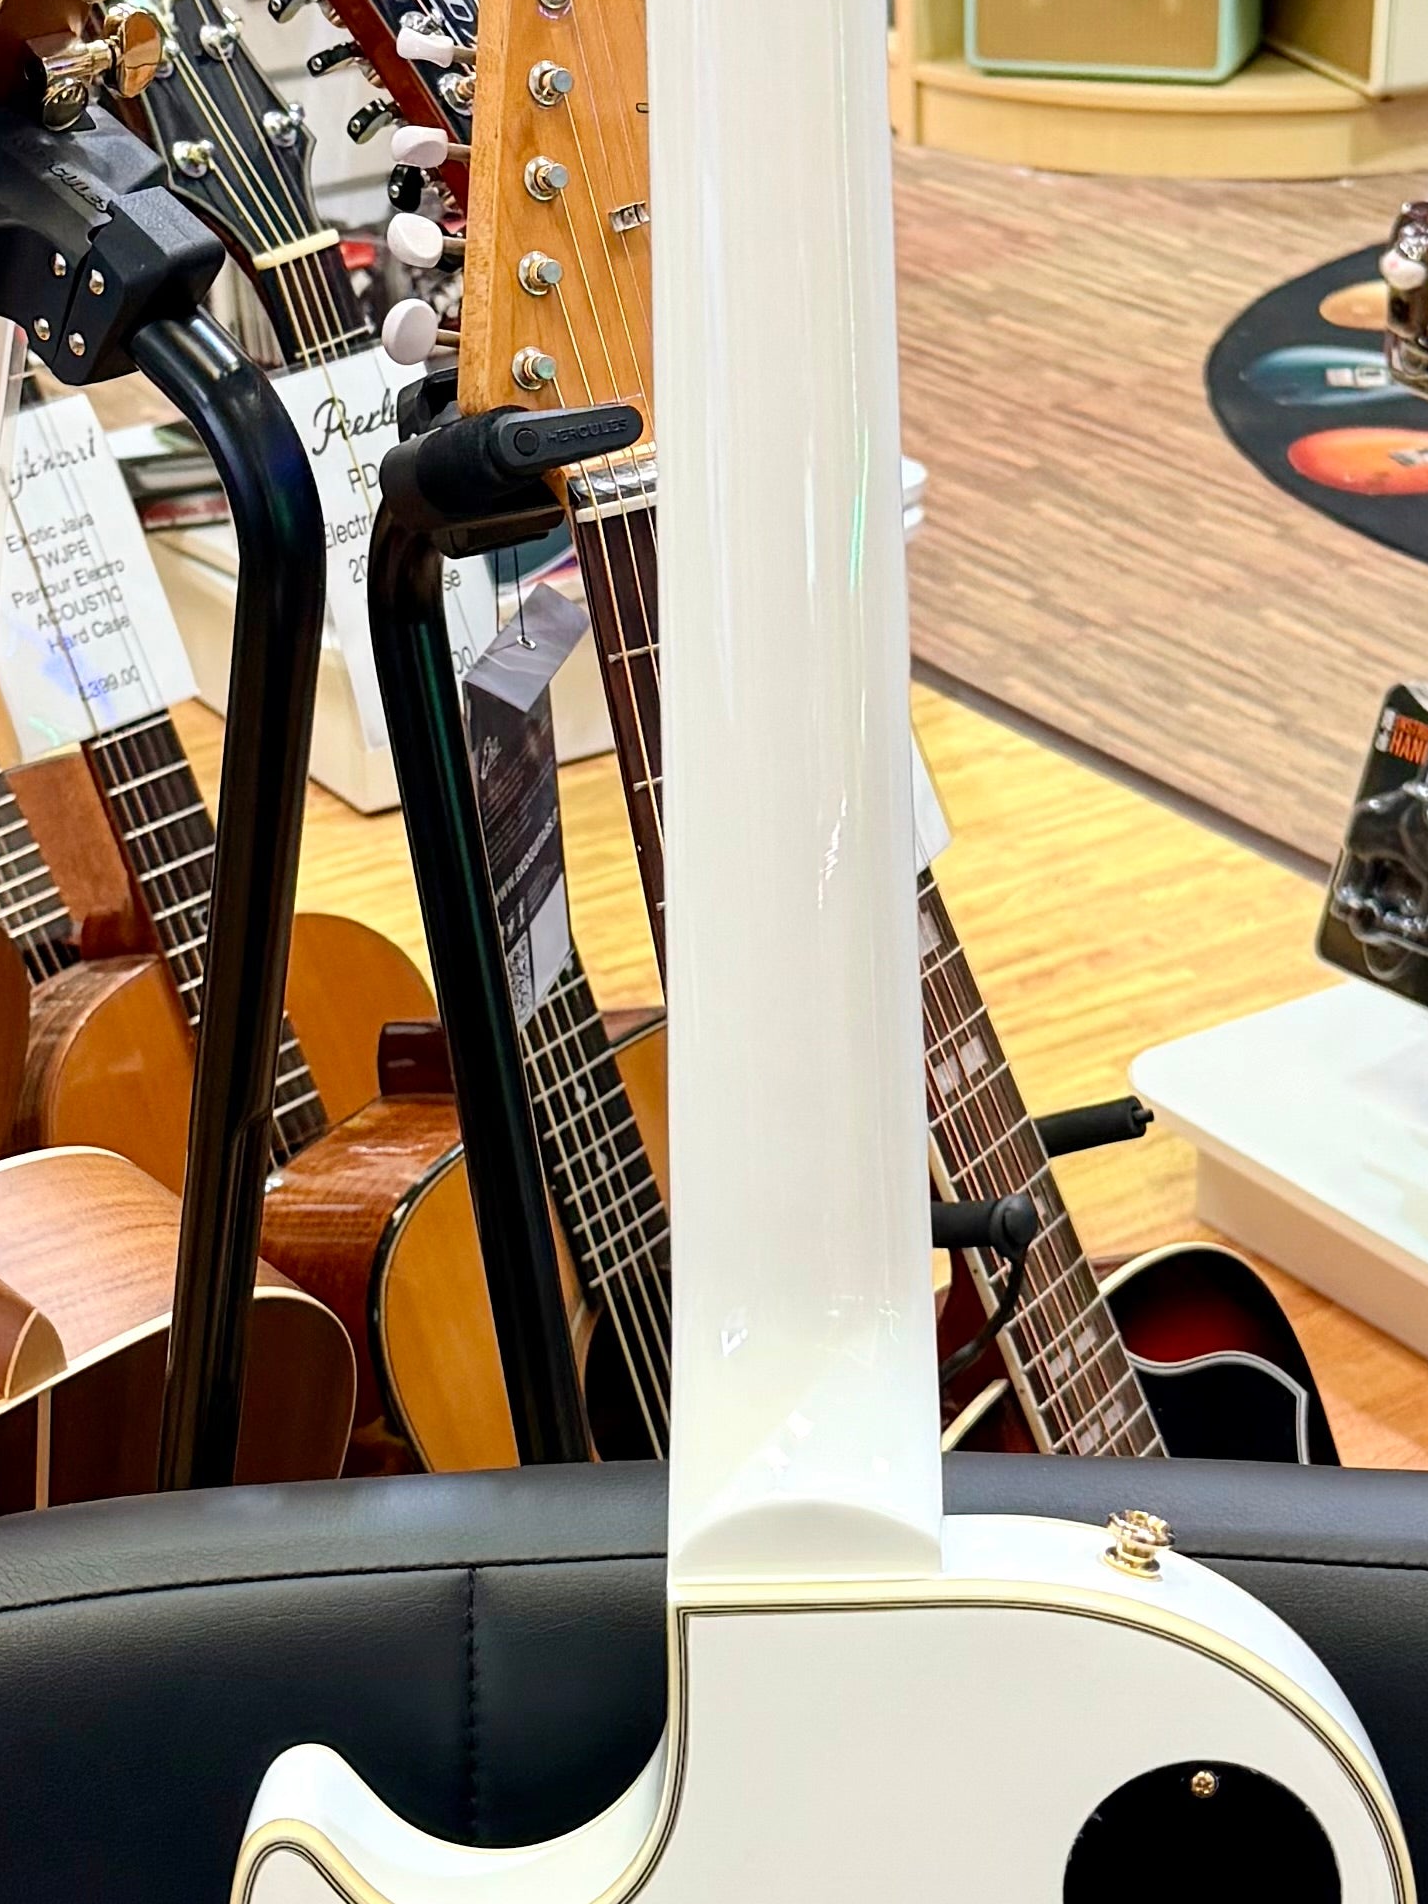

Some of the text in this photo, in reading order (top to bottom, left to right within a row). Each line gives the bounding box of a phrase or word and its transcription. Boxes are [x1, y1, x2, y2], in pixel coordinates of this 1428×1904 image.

[547, 417, 629, 442] HERCULES
[59, 512, 94, 536] Java
[73, 559, 125, 588] Electro
[36, 585, 123, 630] ACOUSTIC
[91, 614, 131, 639] Case
